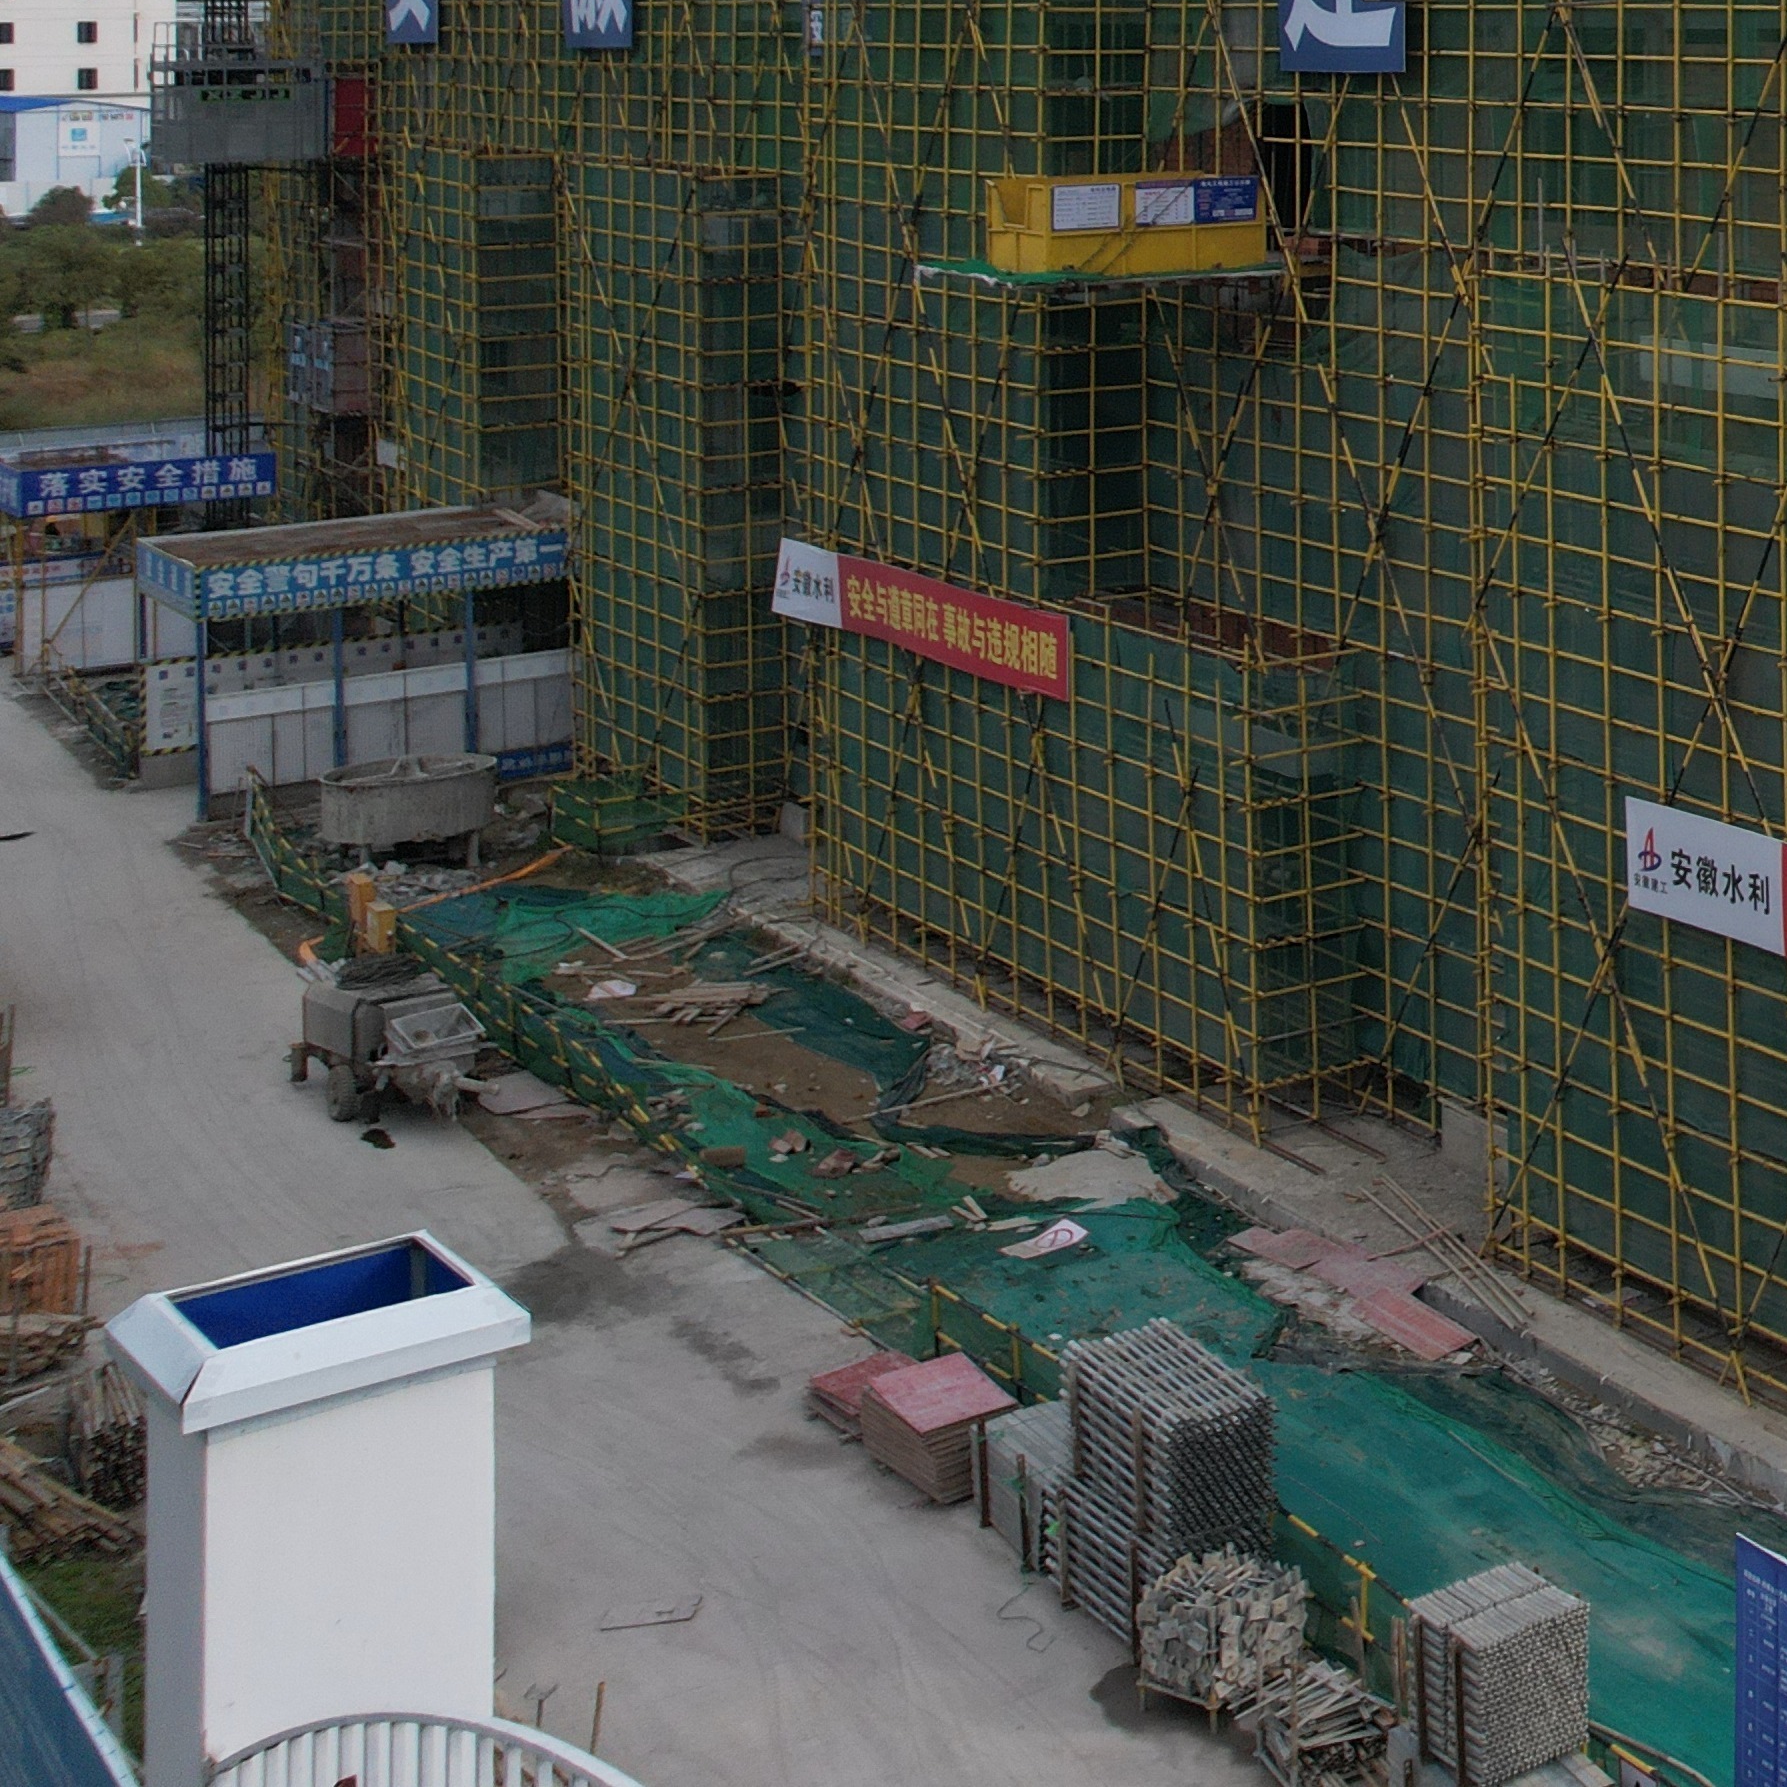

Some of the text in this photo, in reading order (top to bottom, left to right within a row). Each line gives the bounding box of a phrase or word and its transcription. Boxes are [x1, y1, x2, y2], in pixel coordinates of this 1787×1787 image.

[40, 458, 258, 498] 落实安全措施
[1671, 848, 1770, 915] 安徽水利
